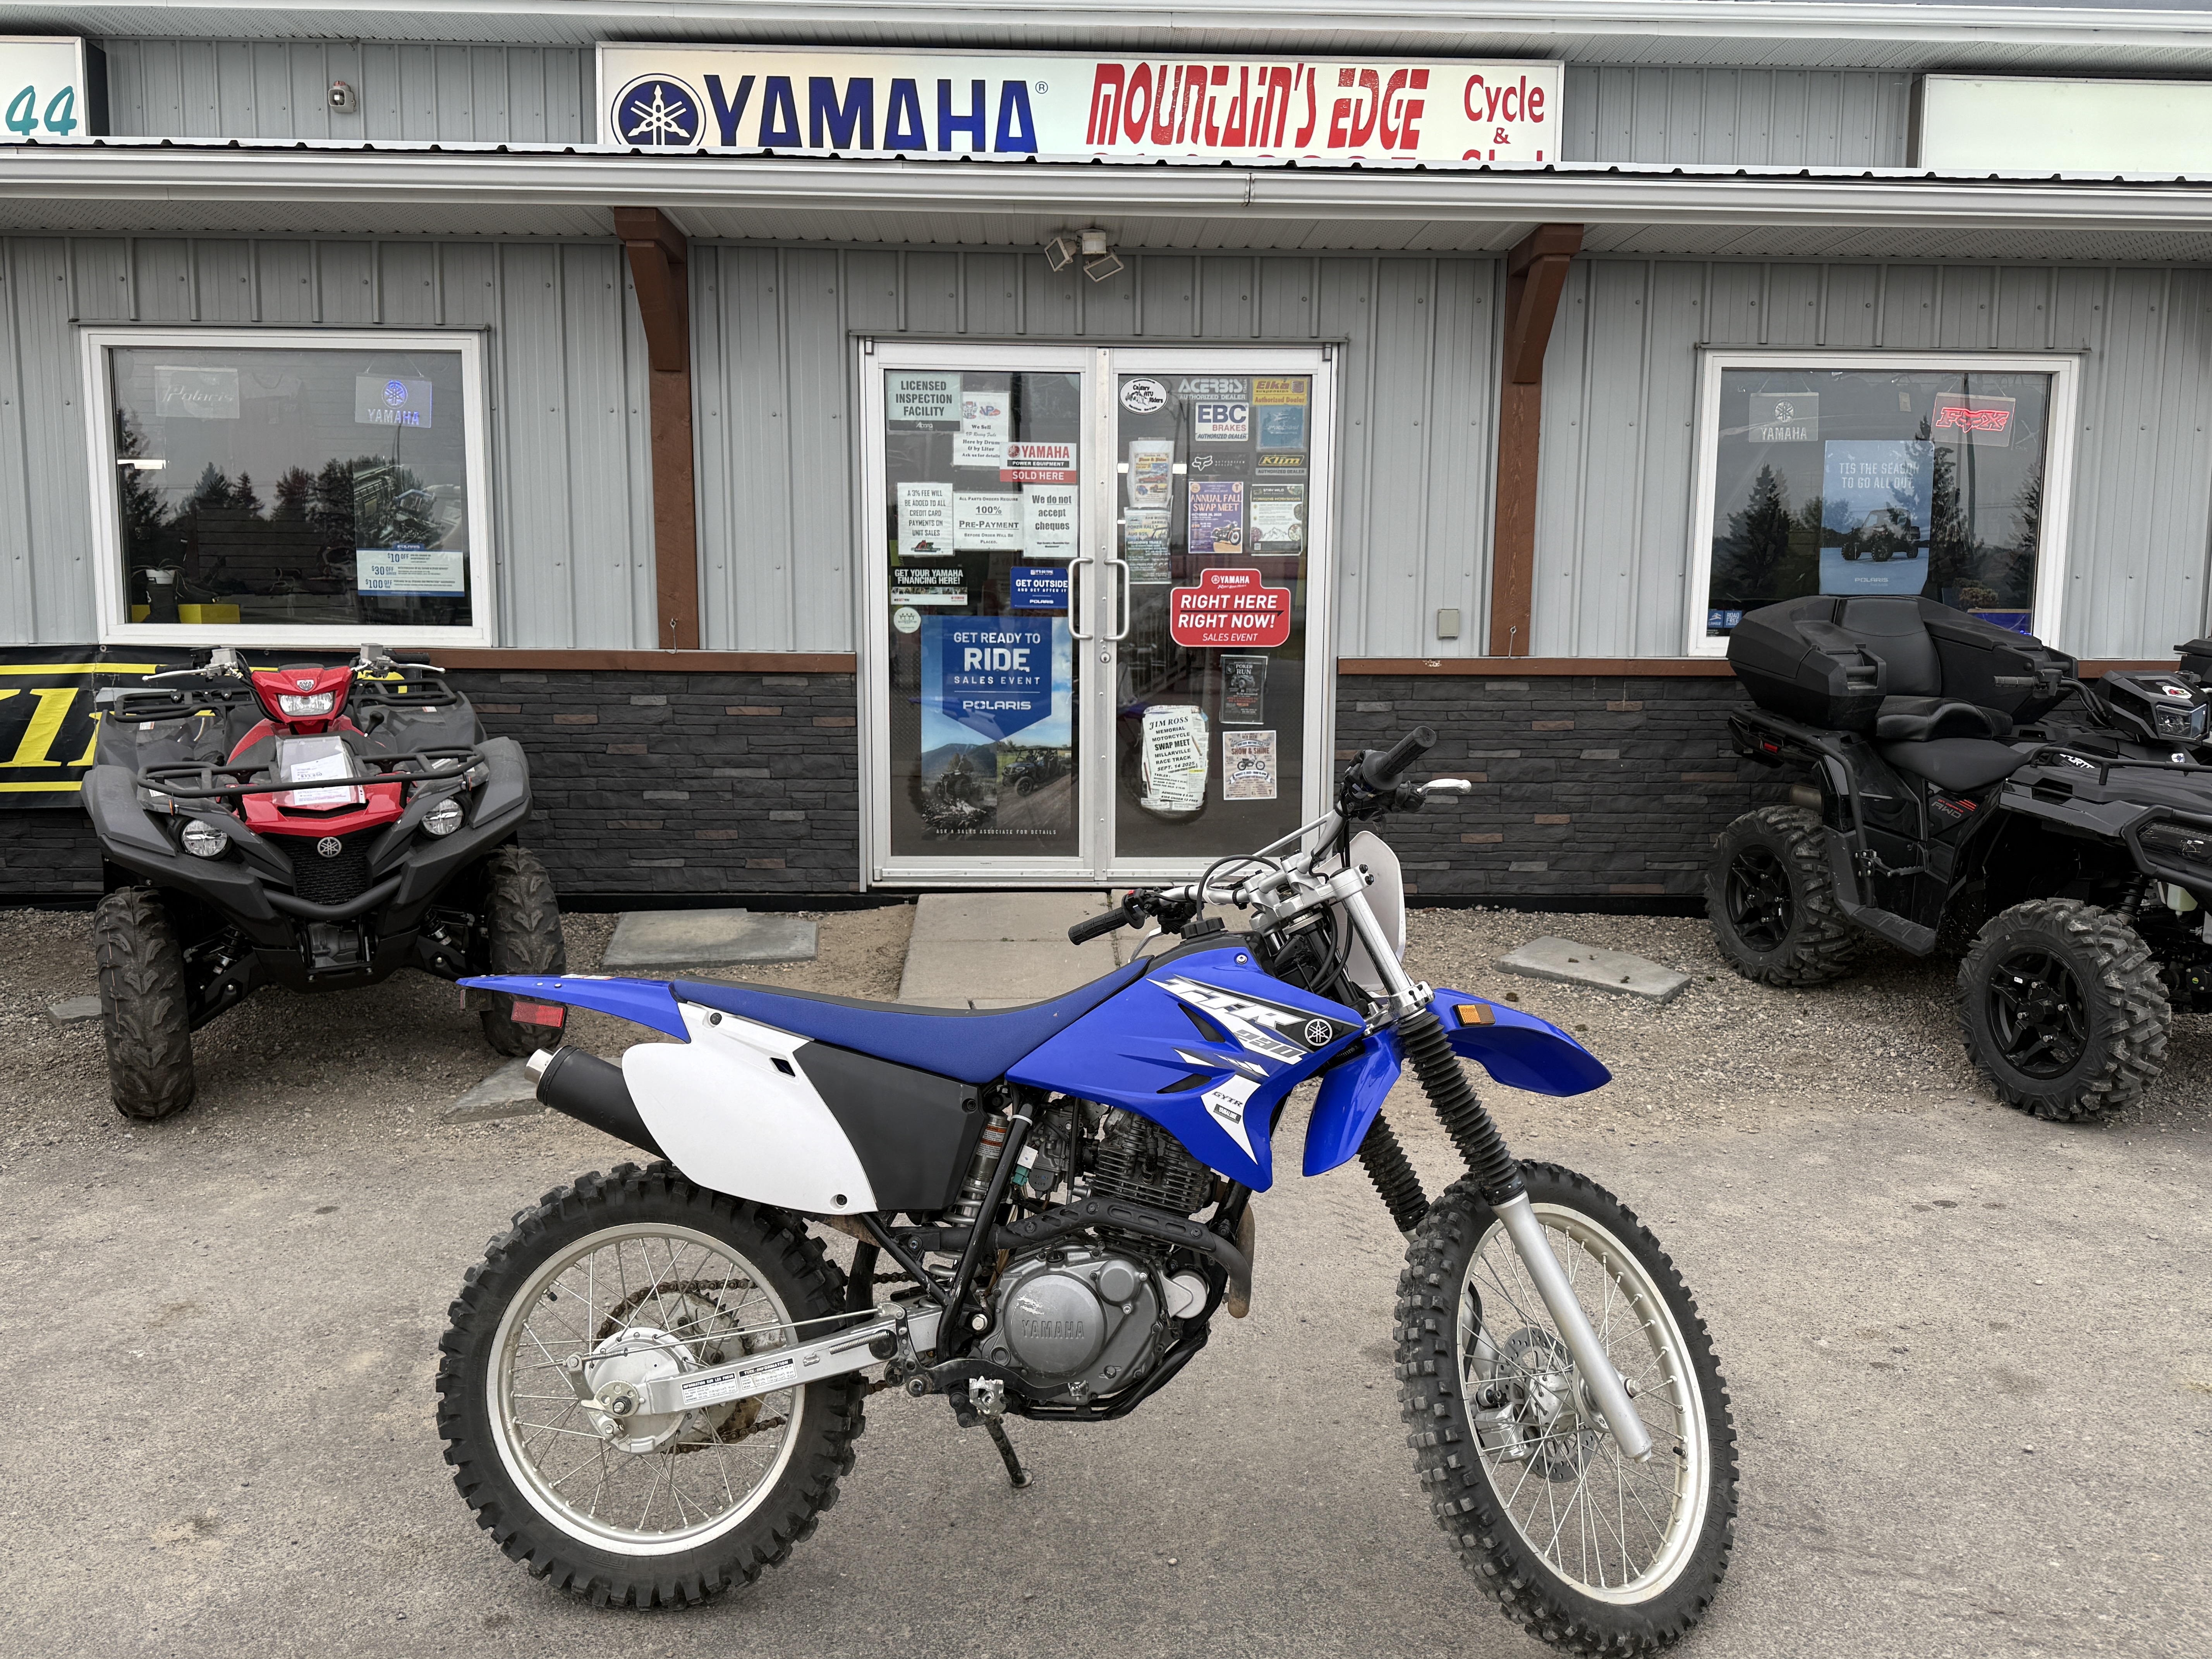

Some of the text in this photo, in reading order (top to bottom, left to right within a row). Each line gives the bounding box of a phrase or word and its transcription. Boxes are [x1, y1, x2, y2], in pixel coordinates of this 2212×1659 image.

[1465, 74, 1544, 122] Cycle
[5, 85, 77, 136] 44
[1086, 62, 1430, 150] MOUNTAIN'S EDGE
[703, 74, 1039, 153] YAMAHA
[1494, 127, 1511, 144] &
[901, 381, 946, 390] LICENSED
[1178, 379, 1243, 393] ACERBIS
[1257, 381, 1290, 389] Elka
[896, 394, 952, 404] INSPECTION
[904, 406, 944, 416] FACILITY
[1198, 405, 1246, 423] EBC
[368, 409, 419, 426] YAMAHA
[1760, 427, 1807, 440] YAMAHA
[1022, 446, 1069, 458] YAMAHA
[1860, 463, 1877, 474] THE
[1881, 462, 1919, 474] SEASON
[1013, 471, 1064, 480] SOLD HERE
[1842, 477, 1915, 488] TO GO ALL OUT.
[1032, 495, 1072, 503] We do not
[1039, 509, 1066, 517] accept
[1035, 522, 1070, 531] cheques
[388, 553, 399, 562] $10
[371, 566, 384, 575] $30
[366, 579, 383, 588] $100
[1181, 595, 1278, 609] RIGHT HERE
[1178, 614, 1275, 628] RIGHT NOW!
[954, 632, 1041, 644] GET READY TO
[964, 648, 1030, 672] RIDE
[954, 676, 993, 684] SALES
[963, 701, 1031, 710] POLARIS
[1149, 716, 1188, 730] JIM ROSS
[1156, 726, 1185, 734] MEMORIAL
[1152, 732, 1190, 742] MOTORCYCLE
[1155, 739, 1190, 751] SWAP MEET
[1155, 749, 1191, 758] MILLARVILLE
[1931, 801, 1961, 818] AWD
[1212, 1092, 1243, 1108] GYTR
[1022, 1320, 1084, 1339] YAMAHA
